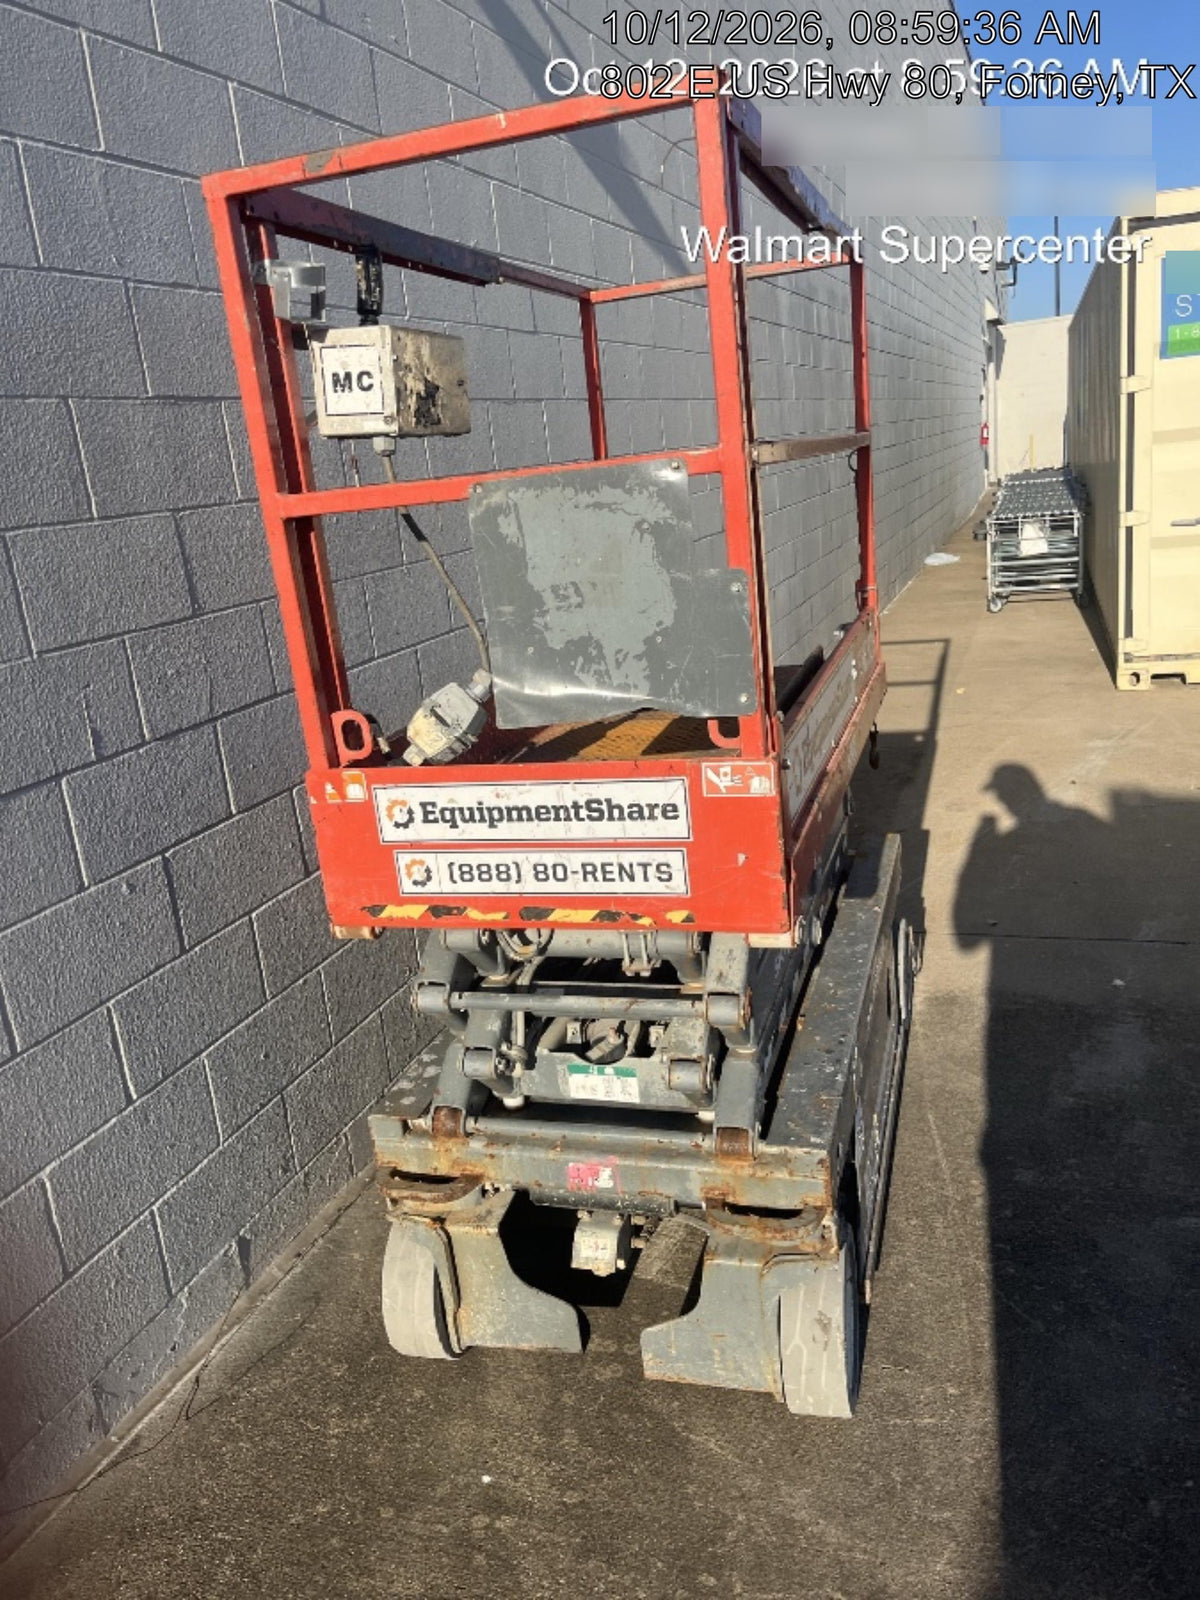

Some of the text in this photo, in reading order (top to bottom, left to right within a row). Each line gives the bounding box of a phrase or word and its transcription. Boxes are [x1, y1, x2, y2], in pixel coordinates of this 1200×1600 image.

[331, 370, 374, 394] MC
[421, 798, 680, 829] EquipmentShare
[448, 861, 673, 884] (888) 80-RENTS
